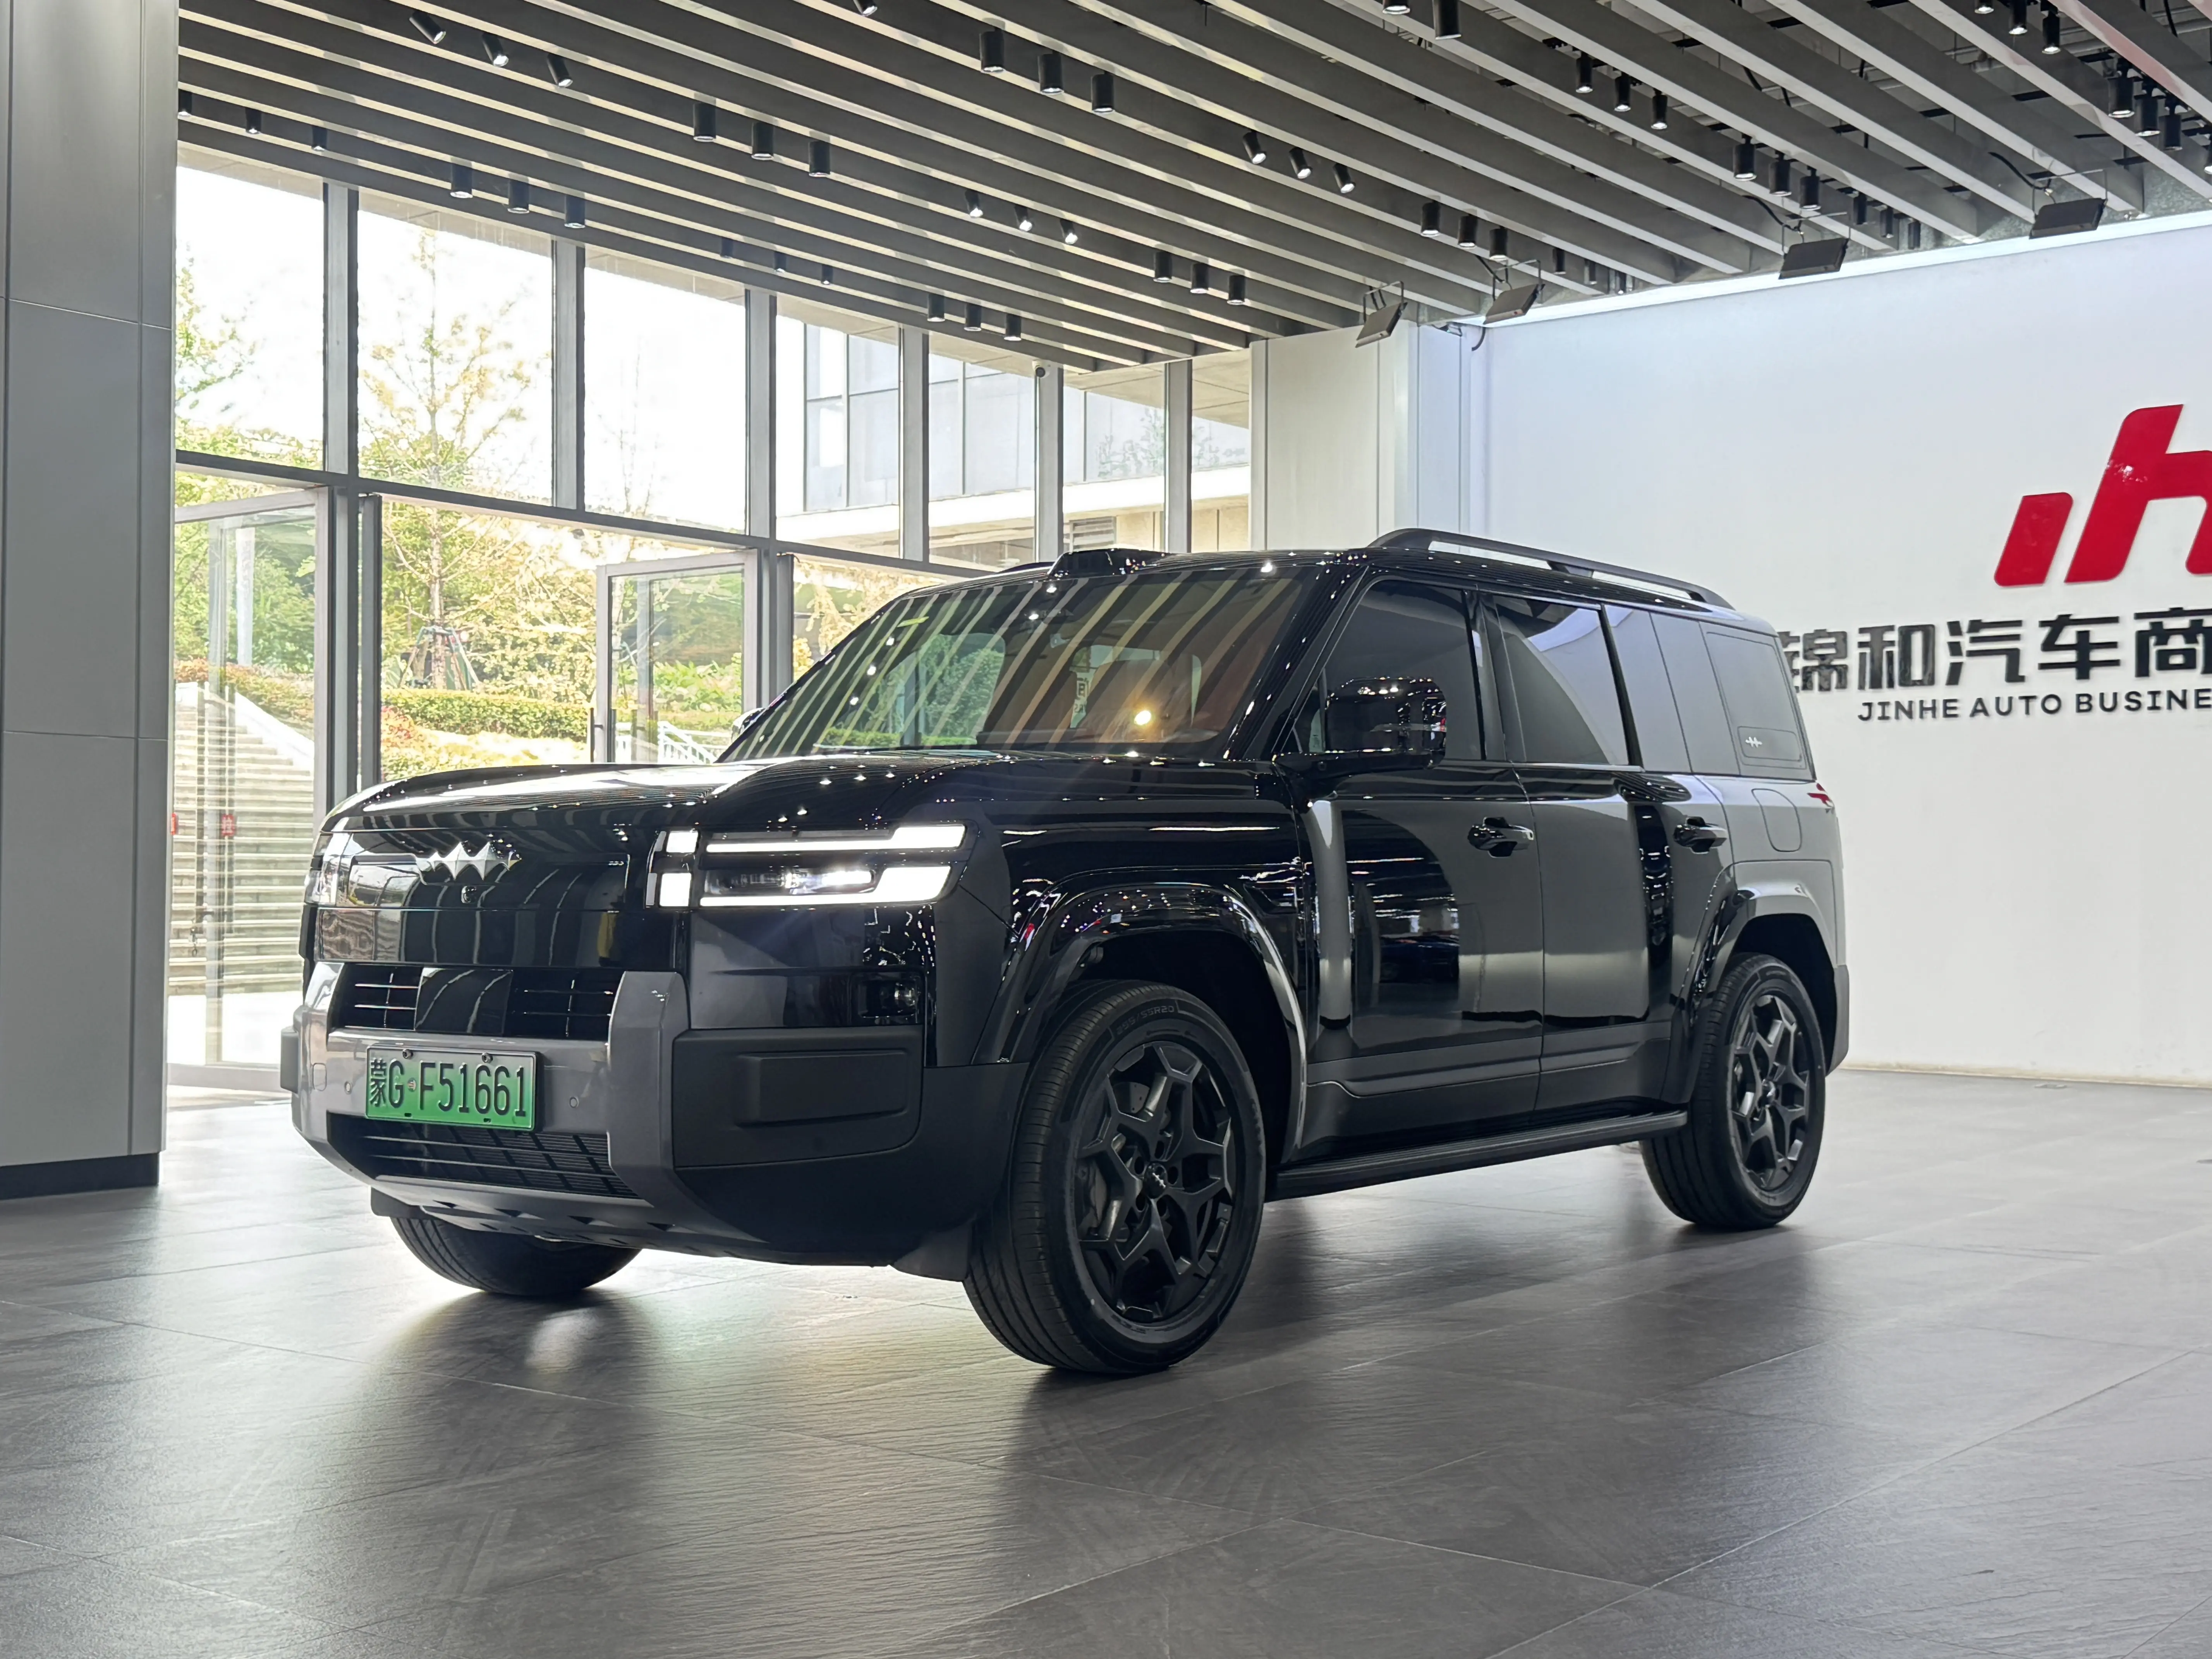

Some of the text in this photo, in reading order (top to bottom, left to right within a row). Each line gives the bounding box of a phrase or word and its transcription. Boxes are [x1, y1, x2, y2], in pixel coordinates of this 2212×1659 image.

[1858, 688, 2212, 721] JINHE AUTO BUSINE
